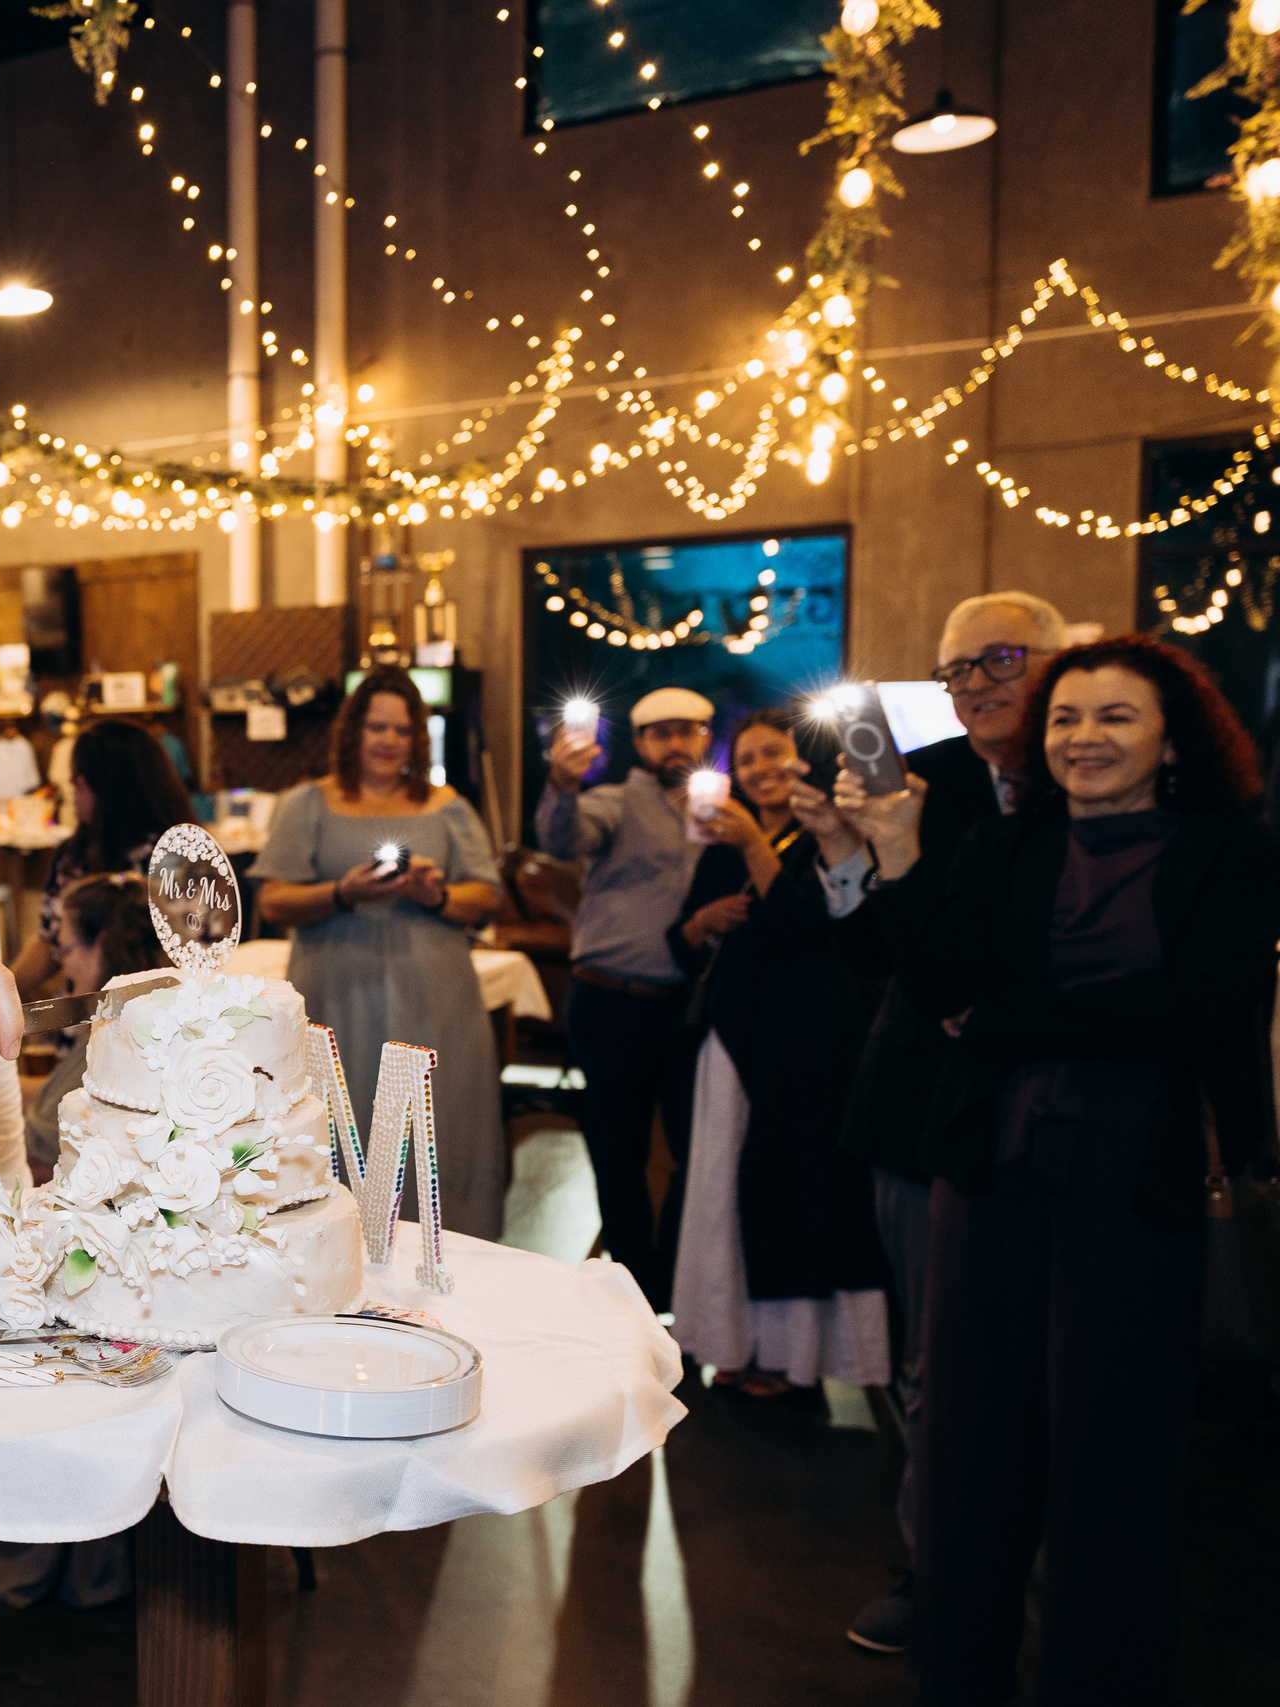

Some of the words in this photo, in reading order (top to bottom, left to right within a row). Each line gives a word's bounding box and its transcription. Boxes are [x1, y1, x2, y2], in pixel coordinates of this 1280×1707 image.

[158, 867, 183, 900] Mr
[186, 878, 196, 899] &
[198, 876, 232, 911] Mrs
